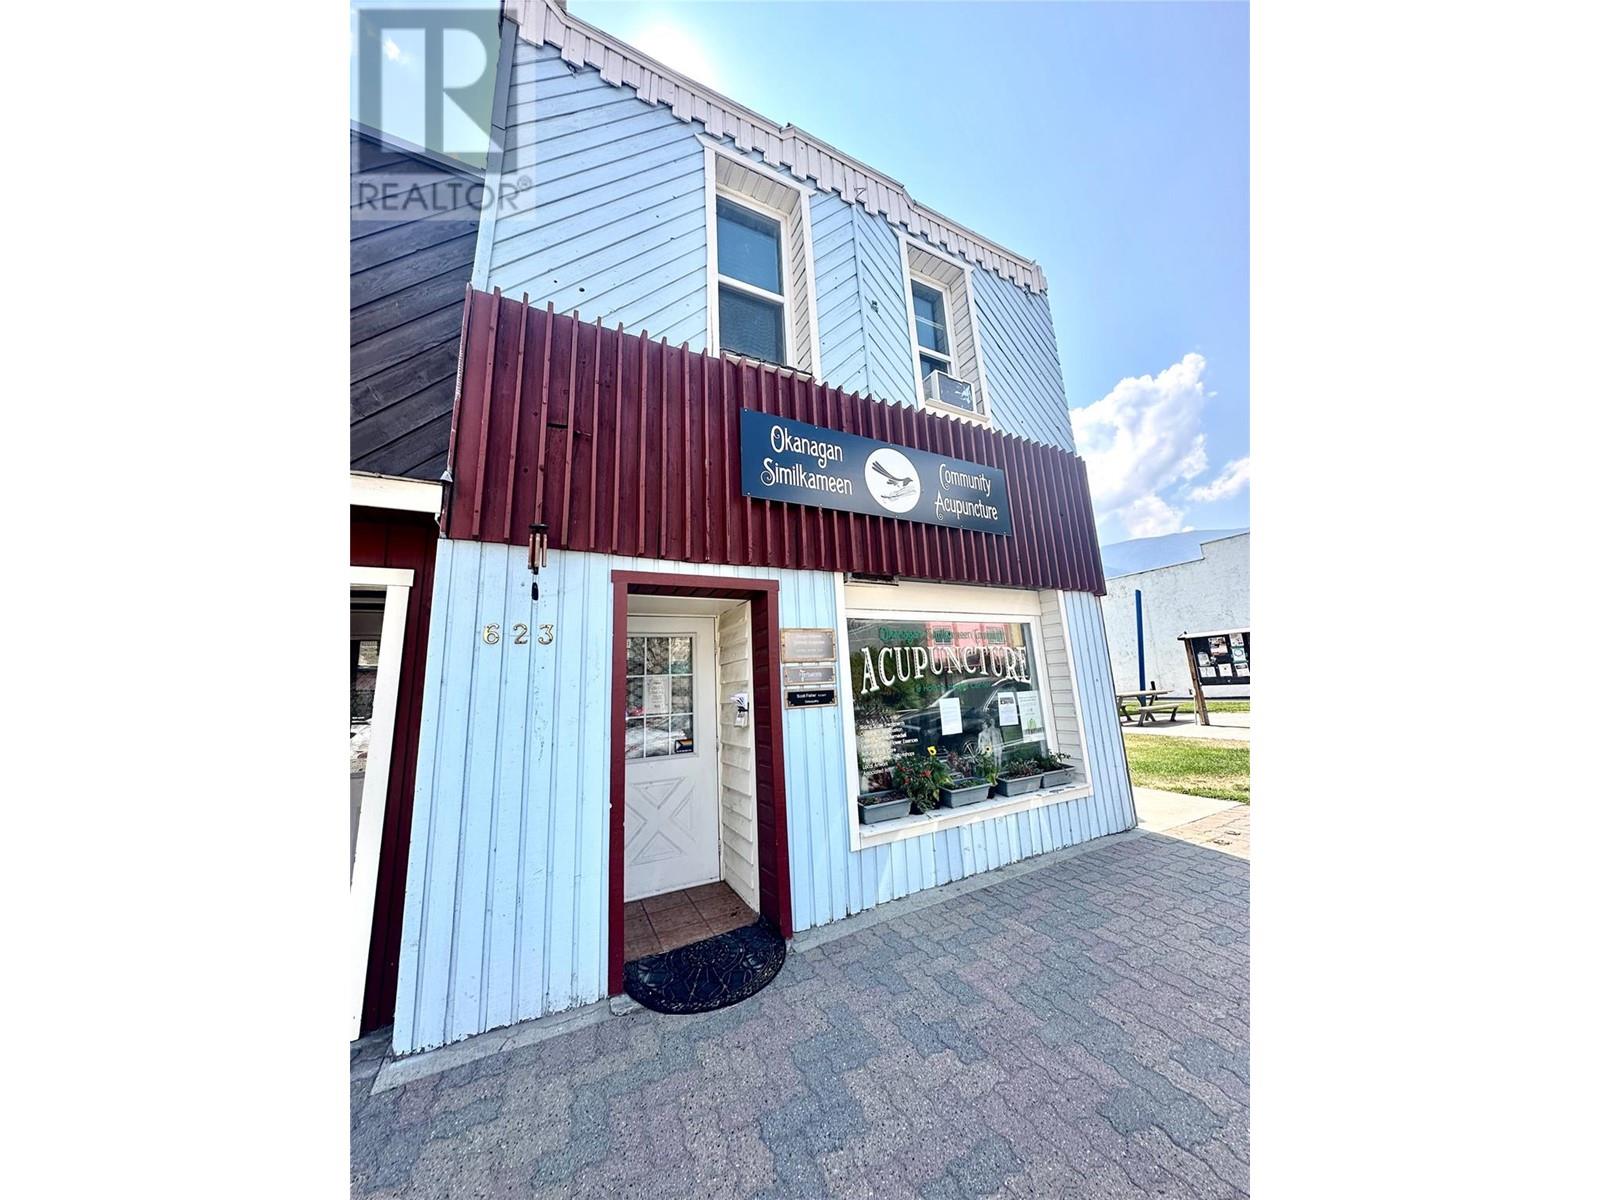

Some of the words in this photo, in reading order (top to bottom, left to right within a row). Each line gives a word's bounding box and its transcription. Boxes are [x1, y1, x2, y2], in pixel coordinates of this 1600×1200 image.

[771, 425, 843, 469] Okanagan
[760, 457, 853, 496] Similkameen
[938, 463, 992, 497] Community
[934, 490, 998, 521] Acupuncture
[861, 645, 1031, 695] ACUPUNCTURE
